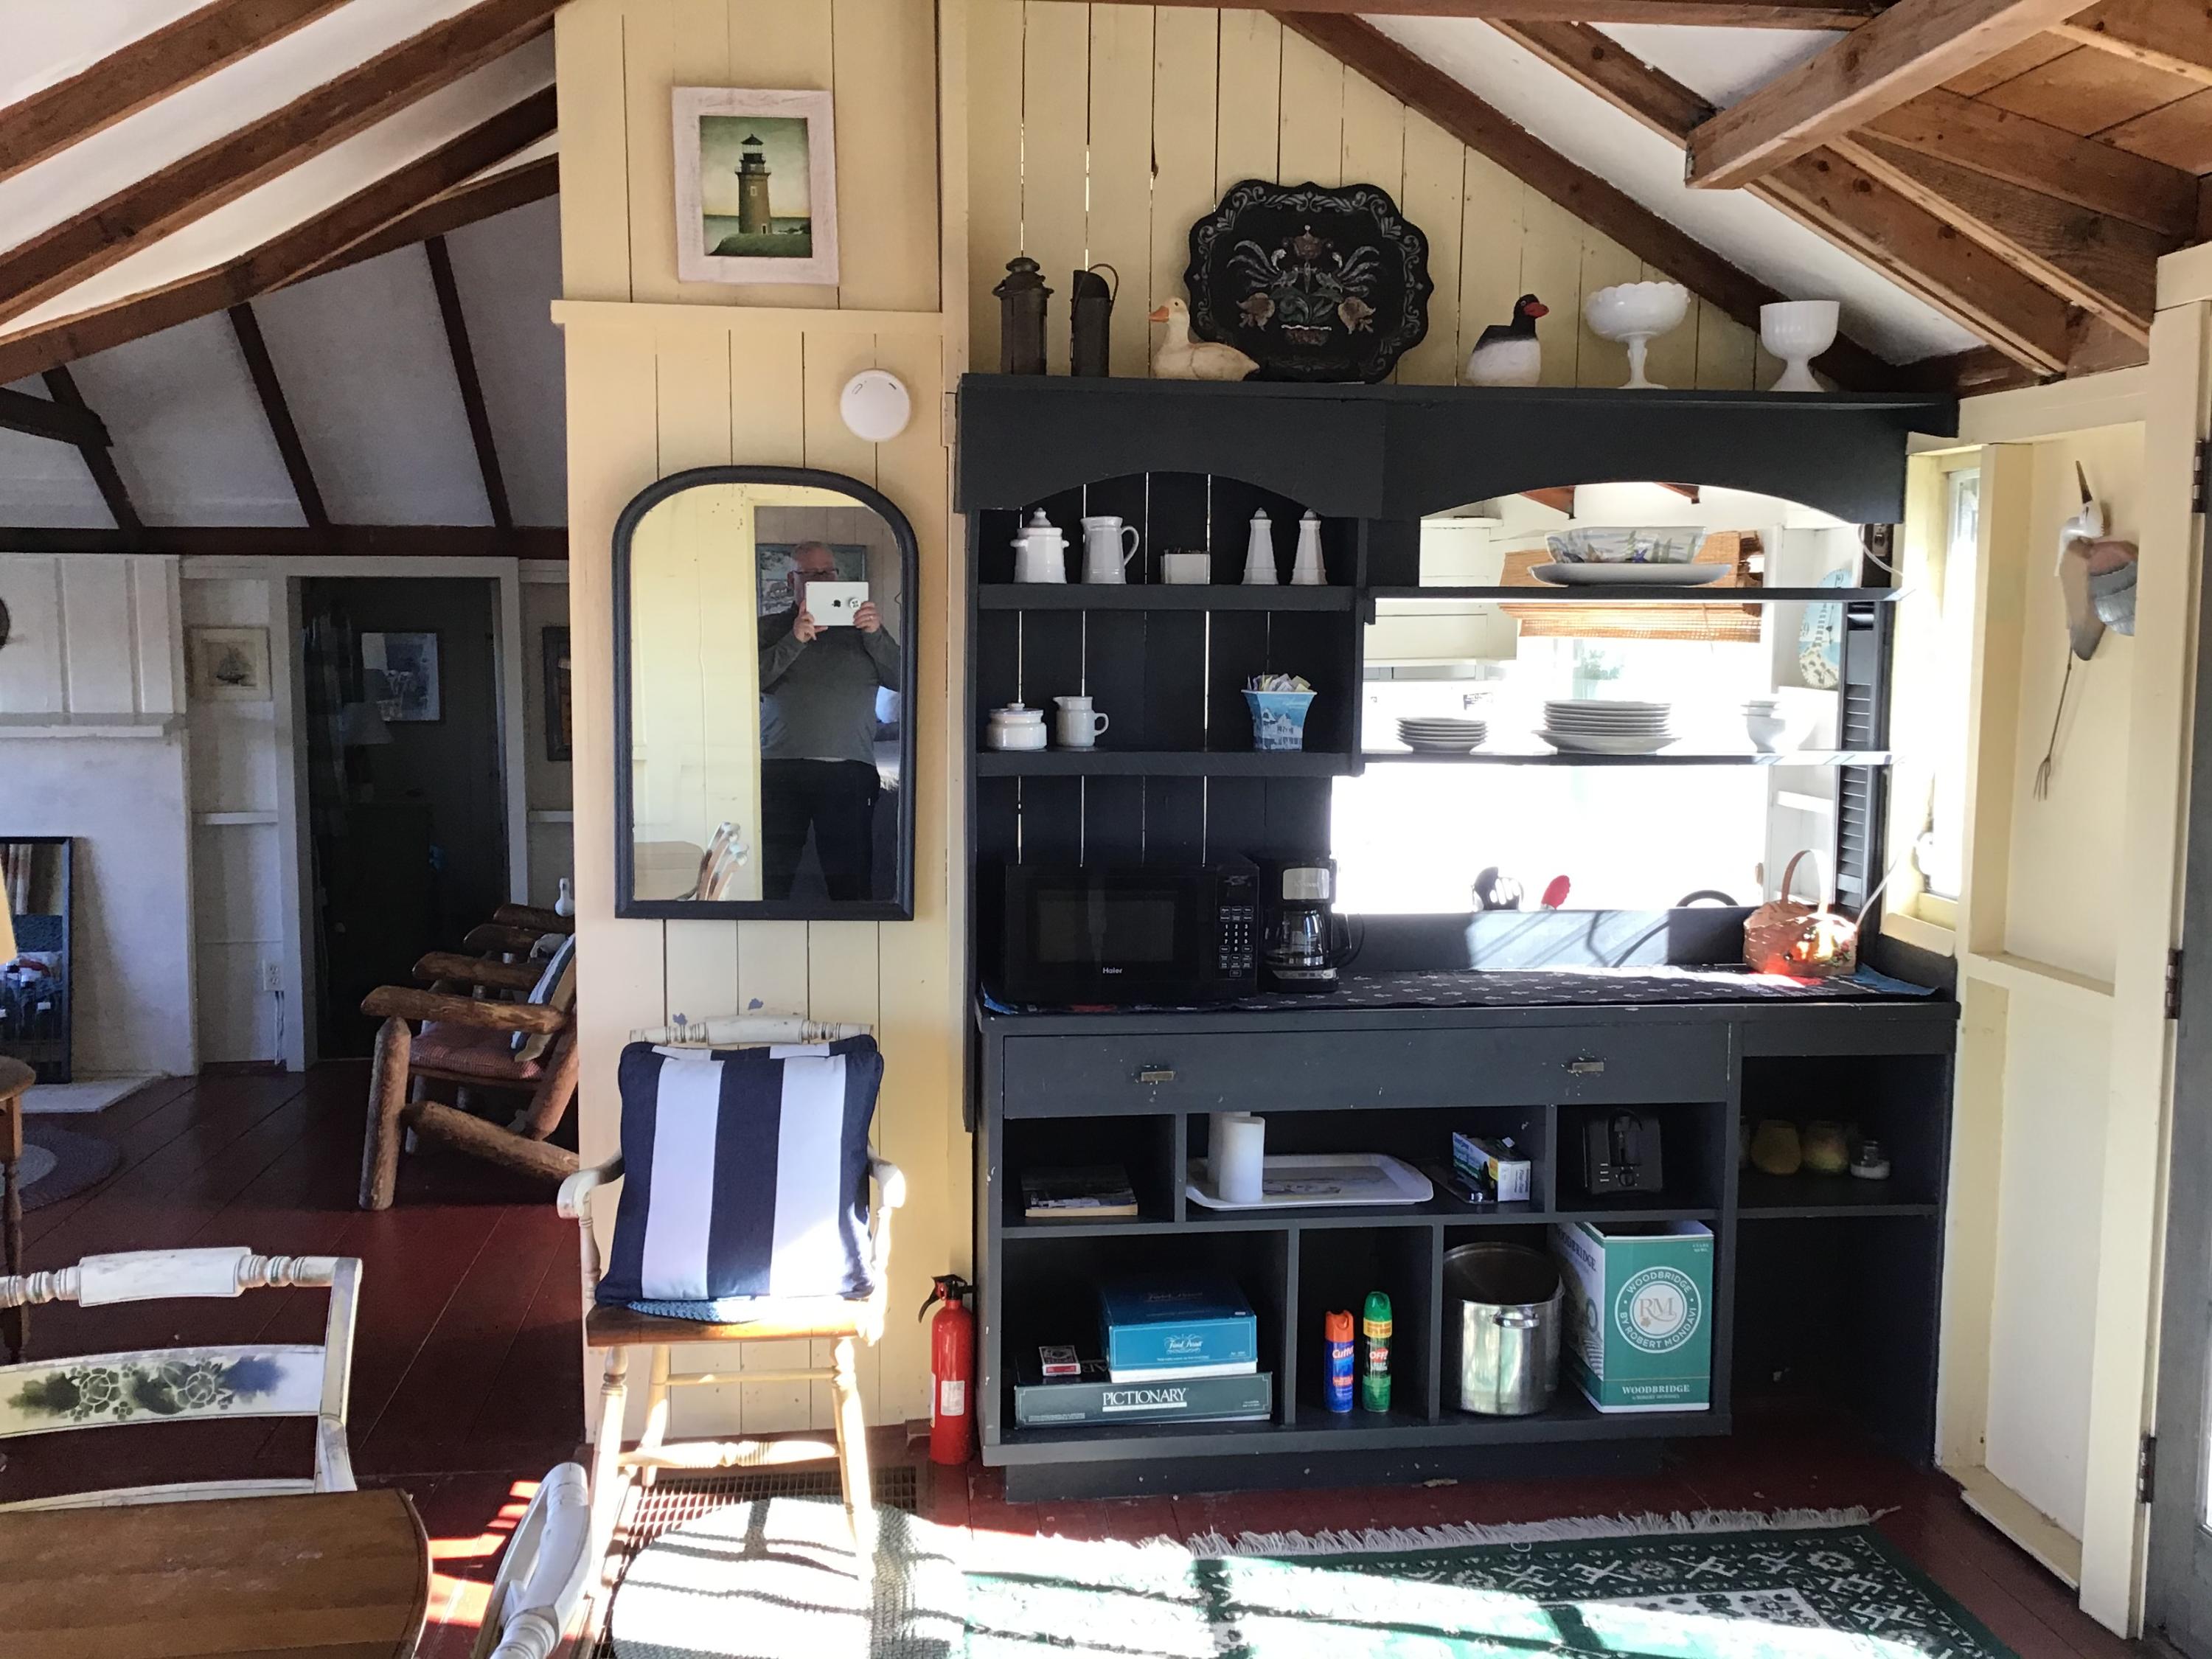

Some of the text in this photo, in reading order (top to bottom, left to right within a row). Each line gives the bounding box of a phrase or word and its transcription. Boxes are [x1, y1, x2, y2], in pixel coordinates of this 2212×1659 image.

[1627, 1271, 1691, 1294] WOODBRIDGE
[1639, 1297, 1677, 1322] RM
[1620, 1307, 1697, 1349] BY ROBERT MONDAVI
[1369, 1350, 1388, 1360] OFF!
[1102, 1388, 1186, 1406] PICTIONARY
[1621, 1385, 1691, 1395] WOODBRIDGE
